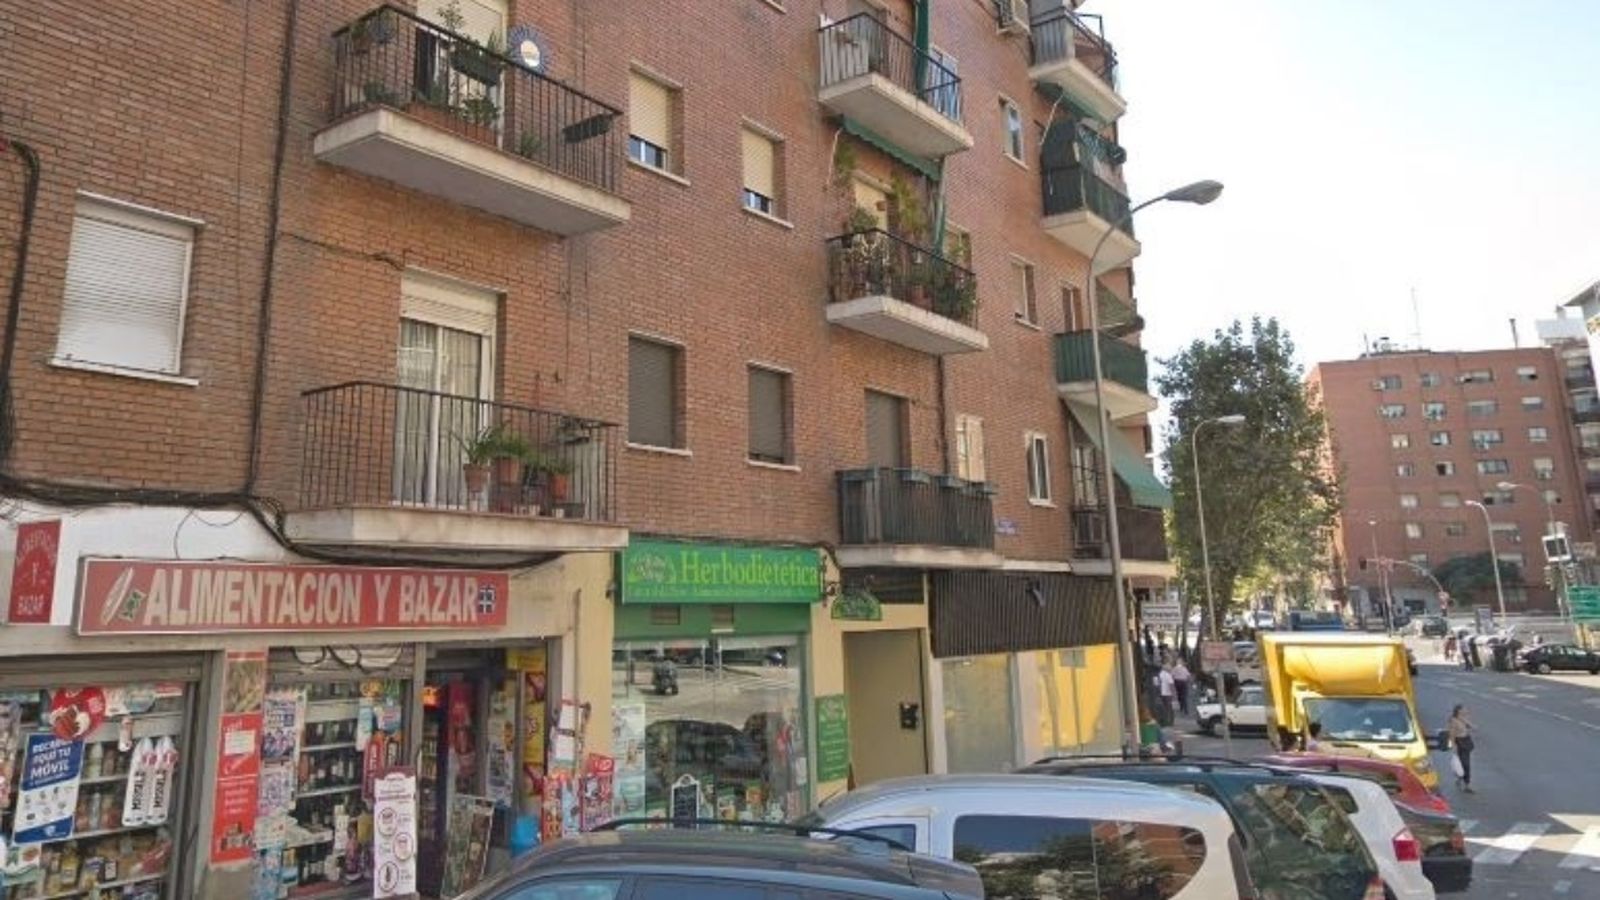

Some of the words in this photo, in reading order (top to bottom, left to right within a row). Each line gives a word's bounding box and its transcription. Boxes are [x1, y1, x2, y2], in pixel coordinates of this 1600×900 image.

[680, 549, 819, 587] Herbodietética
[142, 568, 362, 626] ALIMENTACION
[373, 574, 392, 623] Y
[399, 575, 478, 624] BAZAR
